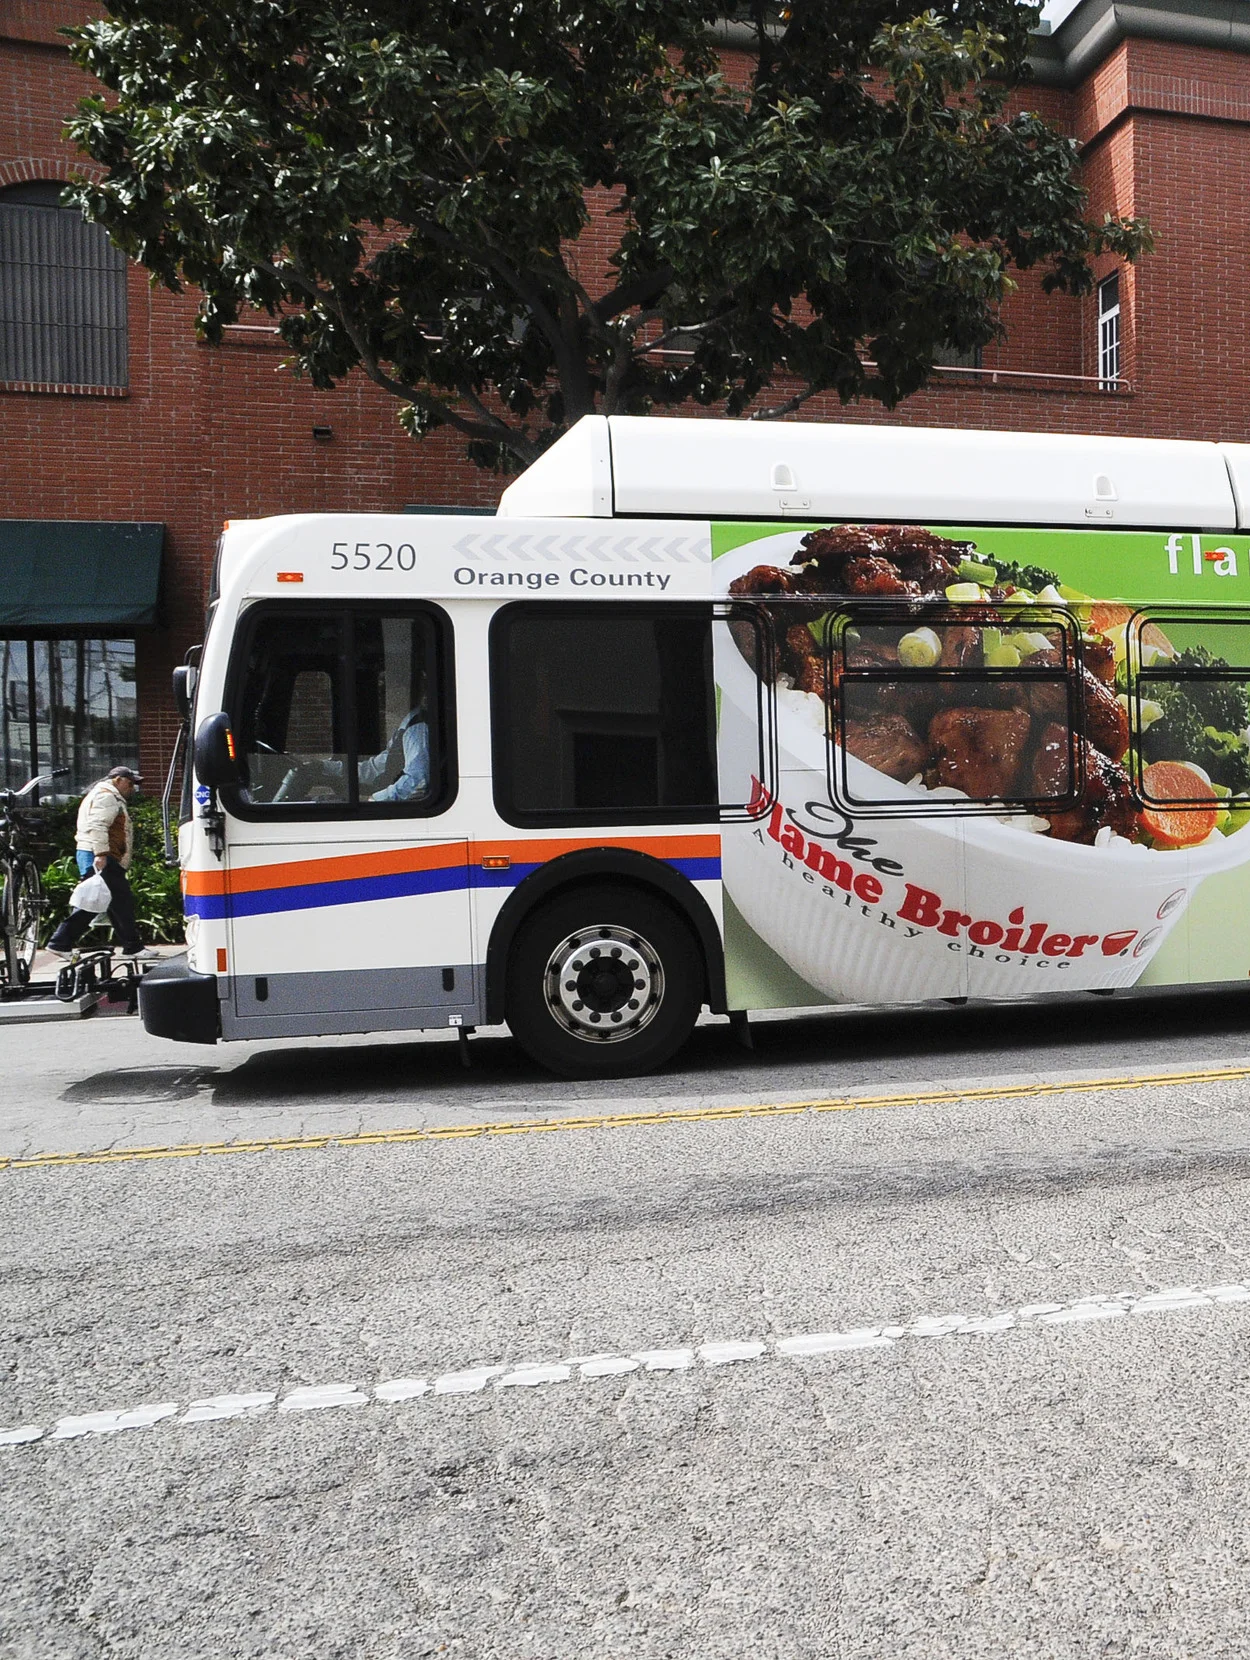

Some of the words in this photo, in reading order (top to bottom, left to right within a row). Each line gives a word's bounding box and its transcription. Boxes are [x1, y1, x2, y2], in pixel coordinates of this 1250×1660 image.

[330, 543, 417, 571] 5520
[454, 567, 560, 589] Orange
[569, 568, 672, 590] County
[195, 790, 210, 799] CNG
[785, 801, 904, 877] The
[781, 850, 923, 938] healthy
[947, 942, 1070, 970] choice
[896, 883, 1099, 957] Broiler
